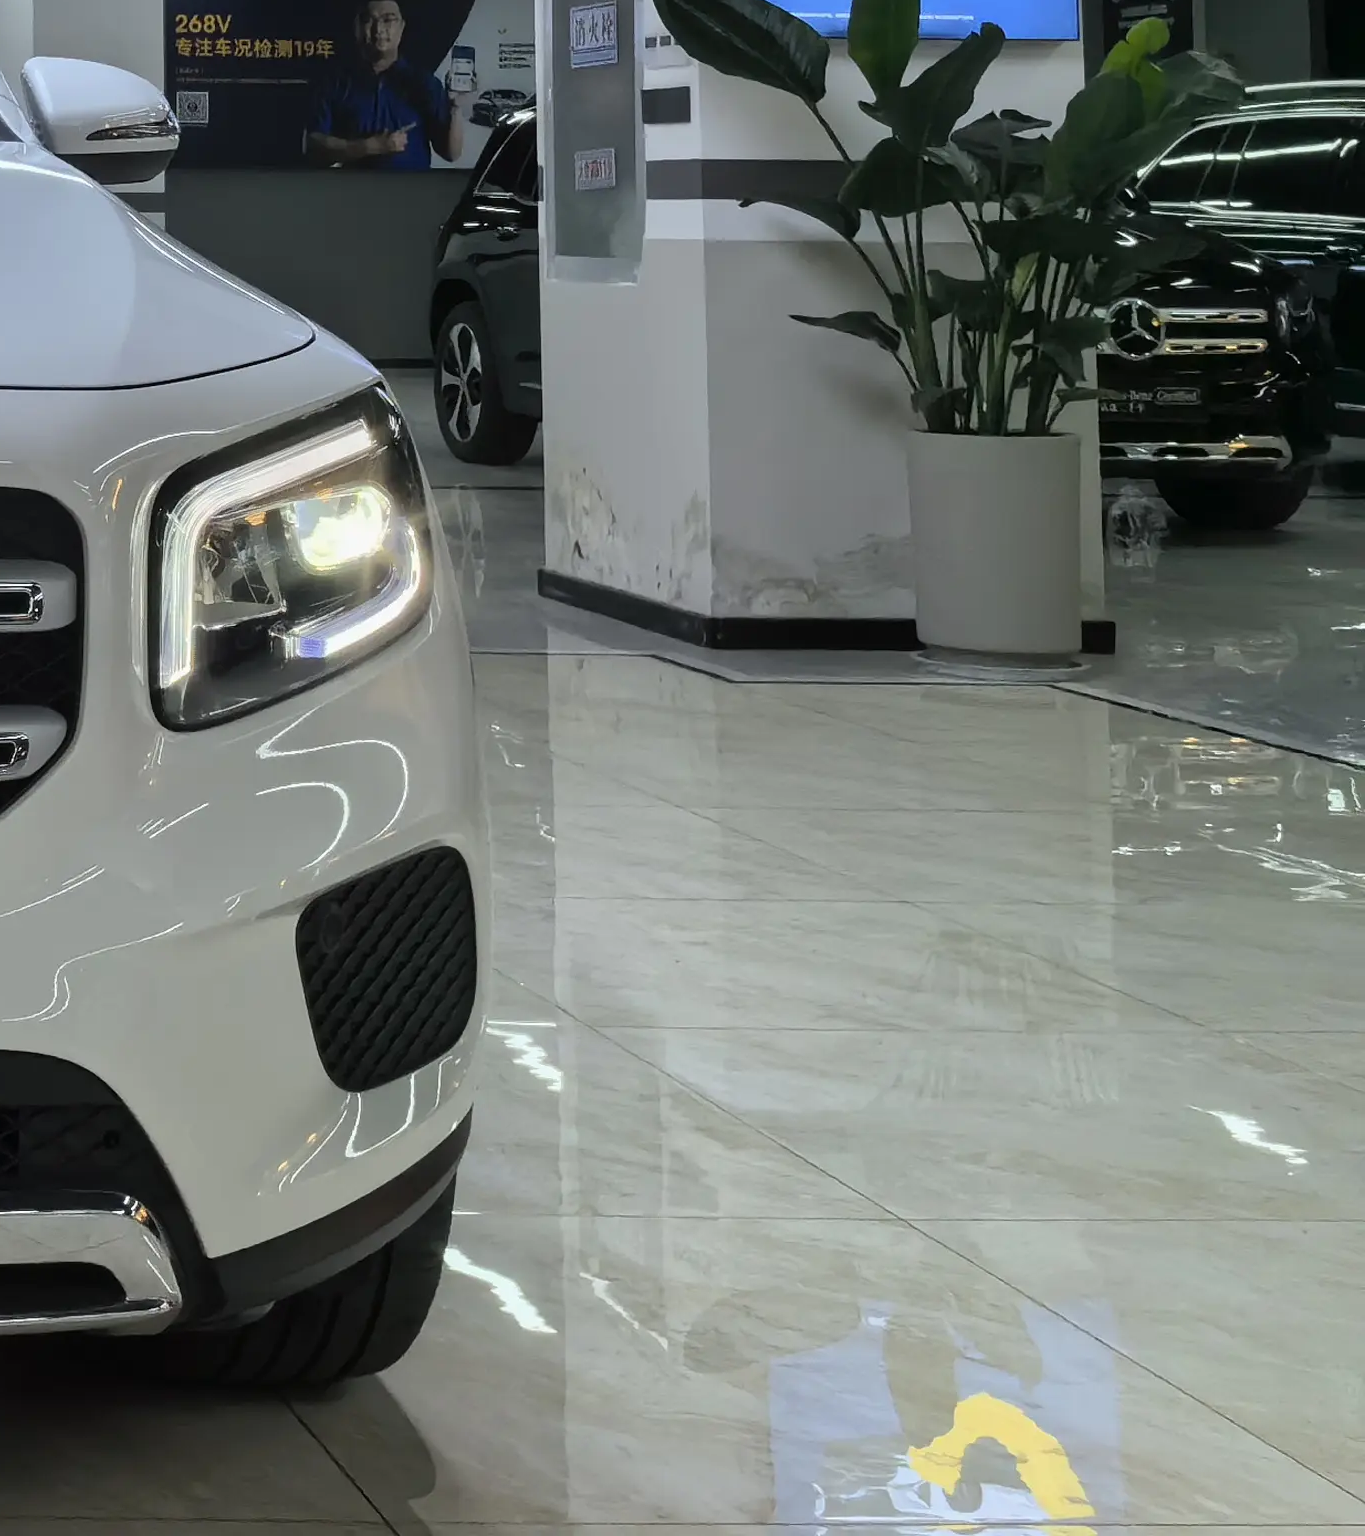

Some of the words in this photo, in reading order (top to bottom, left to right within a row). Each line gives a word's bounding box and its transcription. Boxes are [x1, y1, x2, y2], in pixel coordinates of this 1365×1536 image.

[175, 14, 232, 34] 268V
[175, 37, 335, 59] 专注车况检测19年
